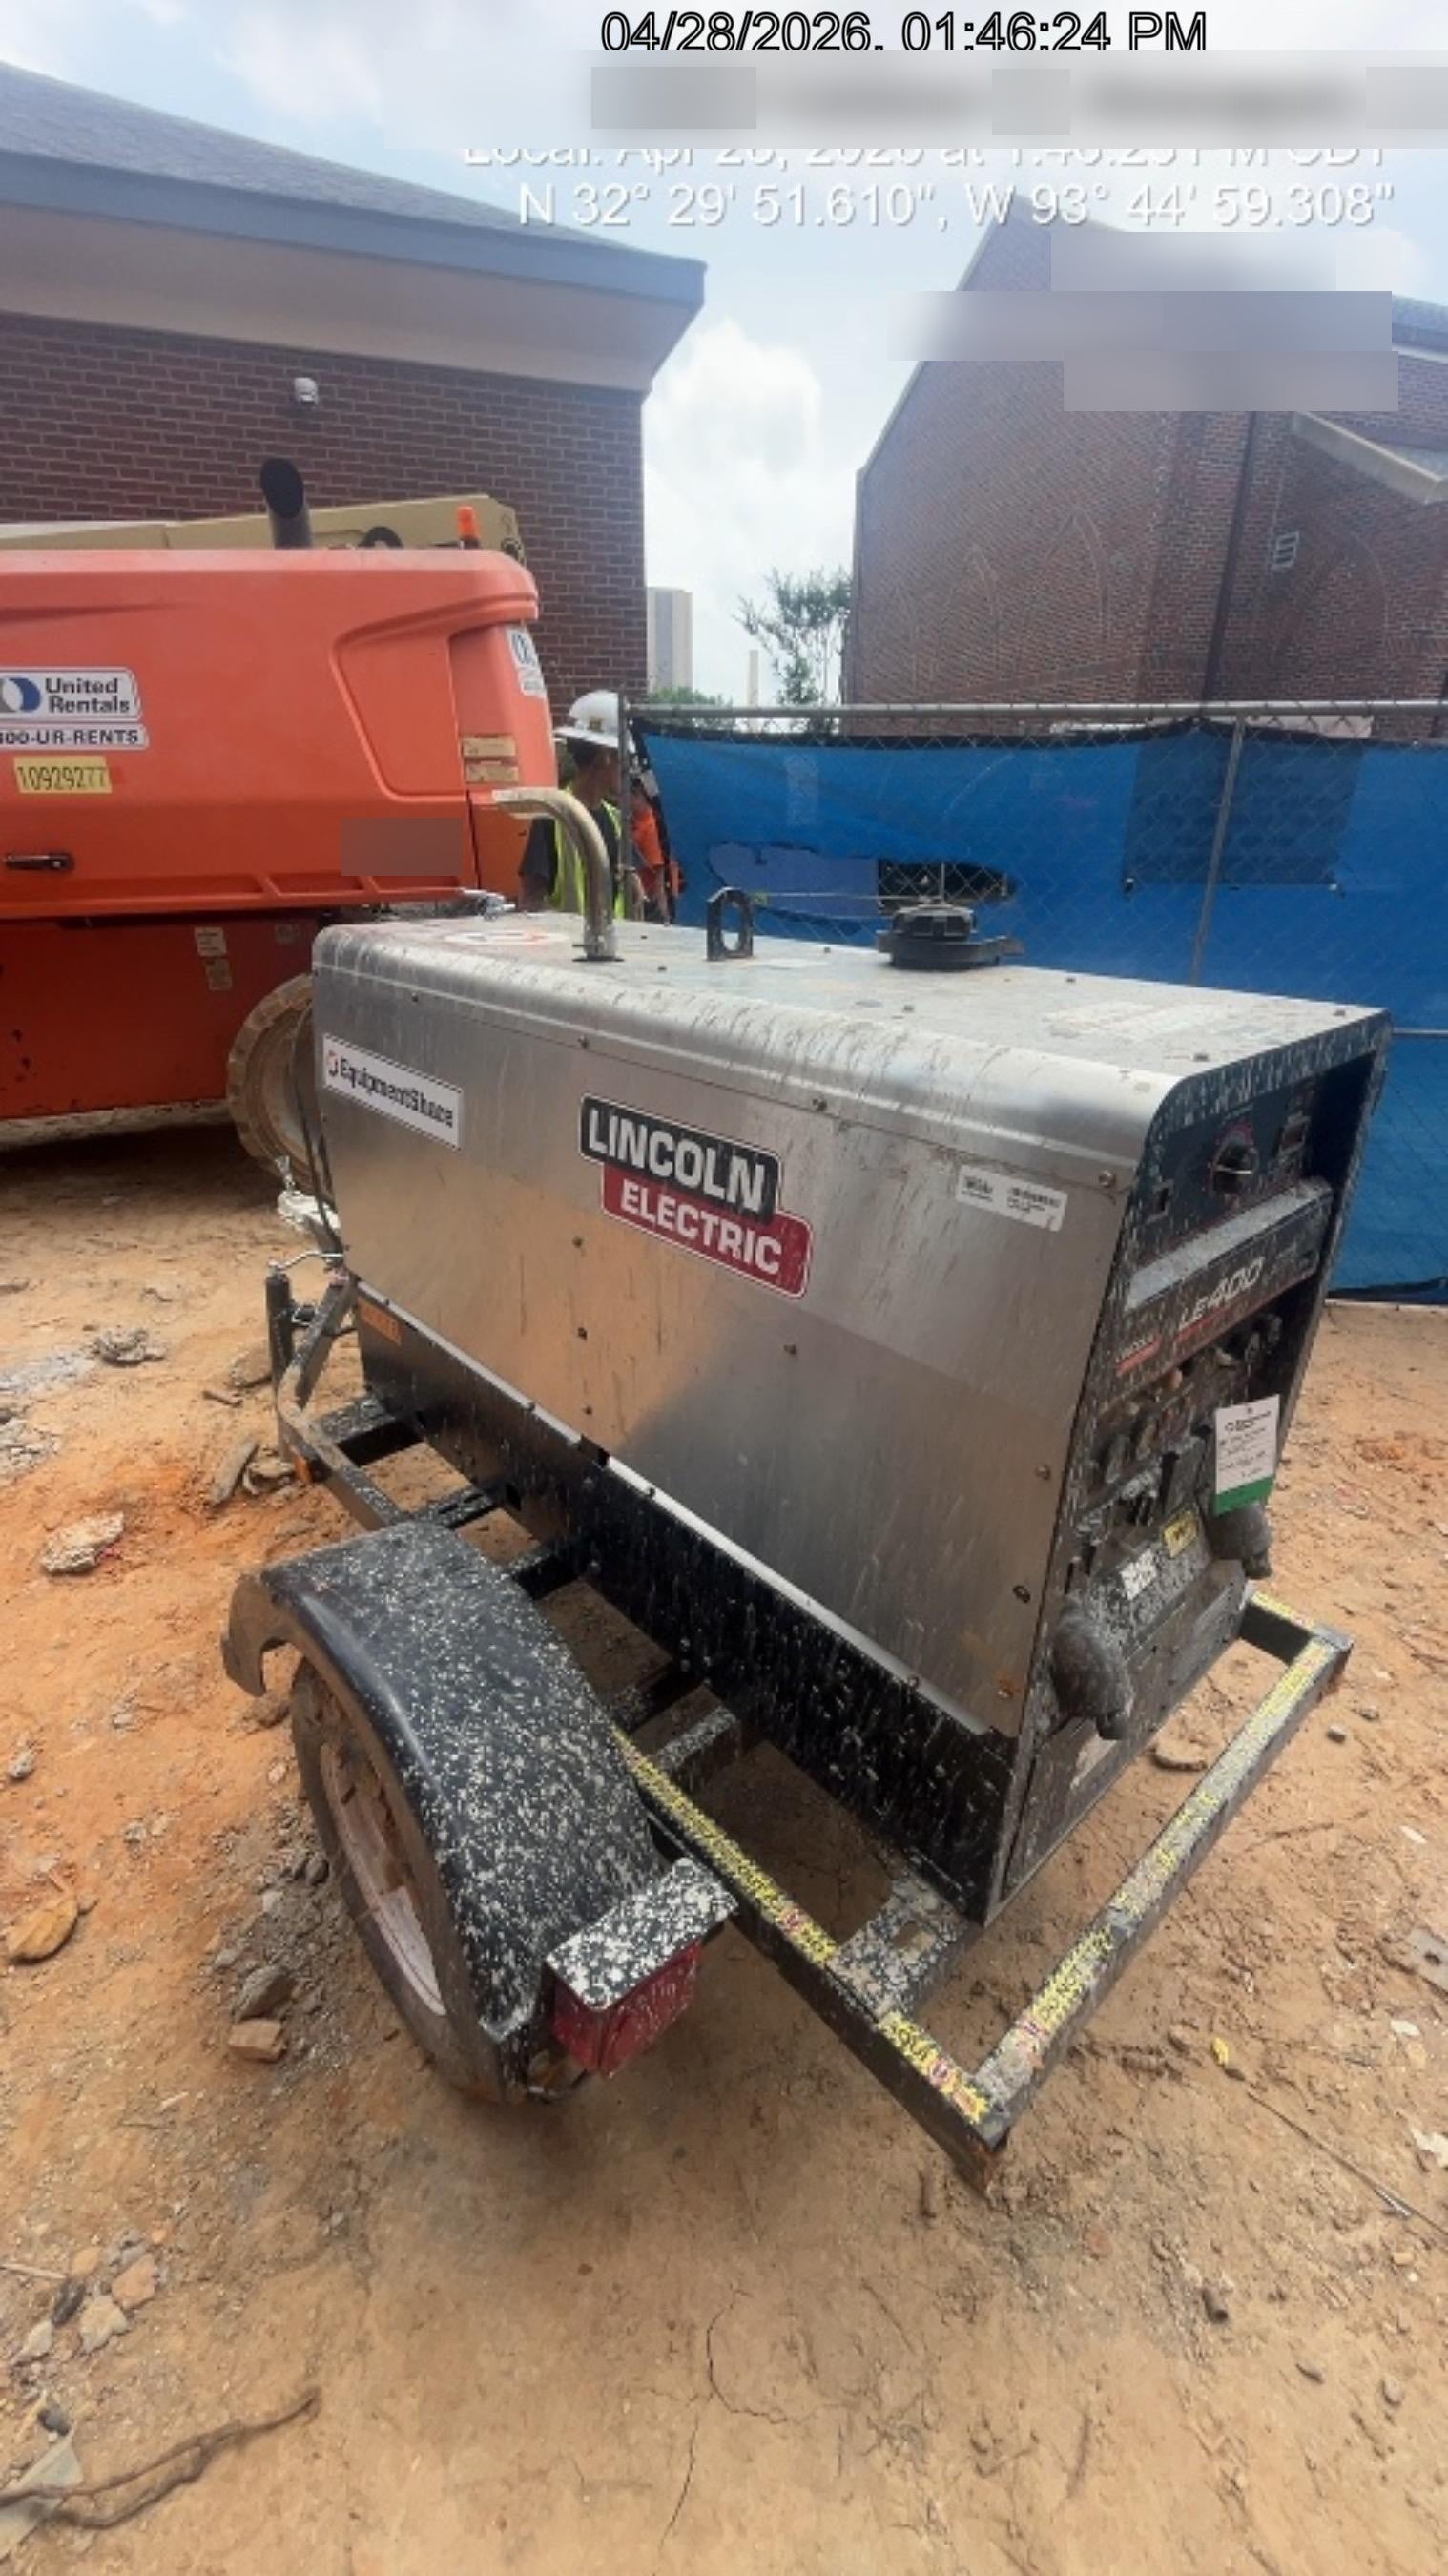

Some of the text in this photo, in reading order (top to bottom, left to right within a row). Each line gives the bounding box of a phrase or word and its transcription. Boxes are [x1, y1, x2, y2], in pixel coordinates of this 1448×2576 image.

[46, 677, 118, 694] United
[49, 696, 130, 713] Rentals
[0, 729, 138, 744] 00-UR-RENTS
[588, 1109, 766, 1215] LINCOLN
[620, 1178, 782, 1275] ELECTRIC
